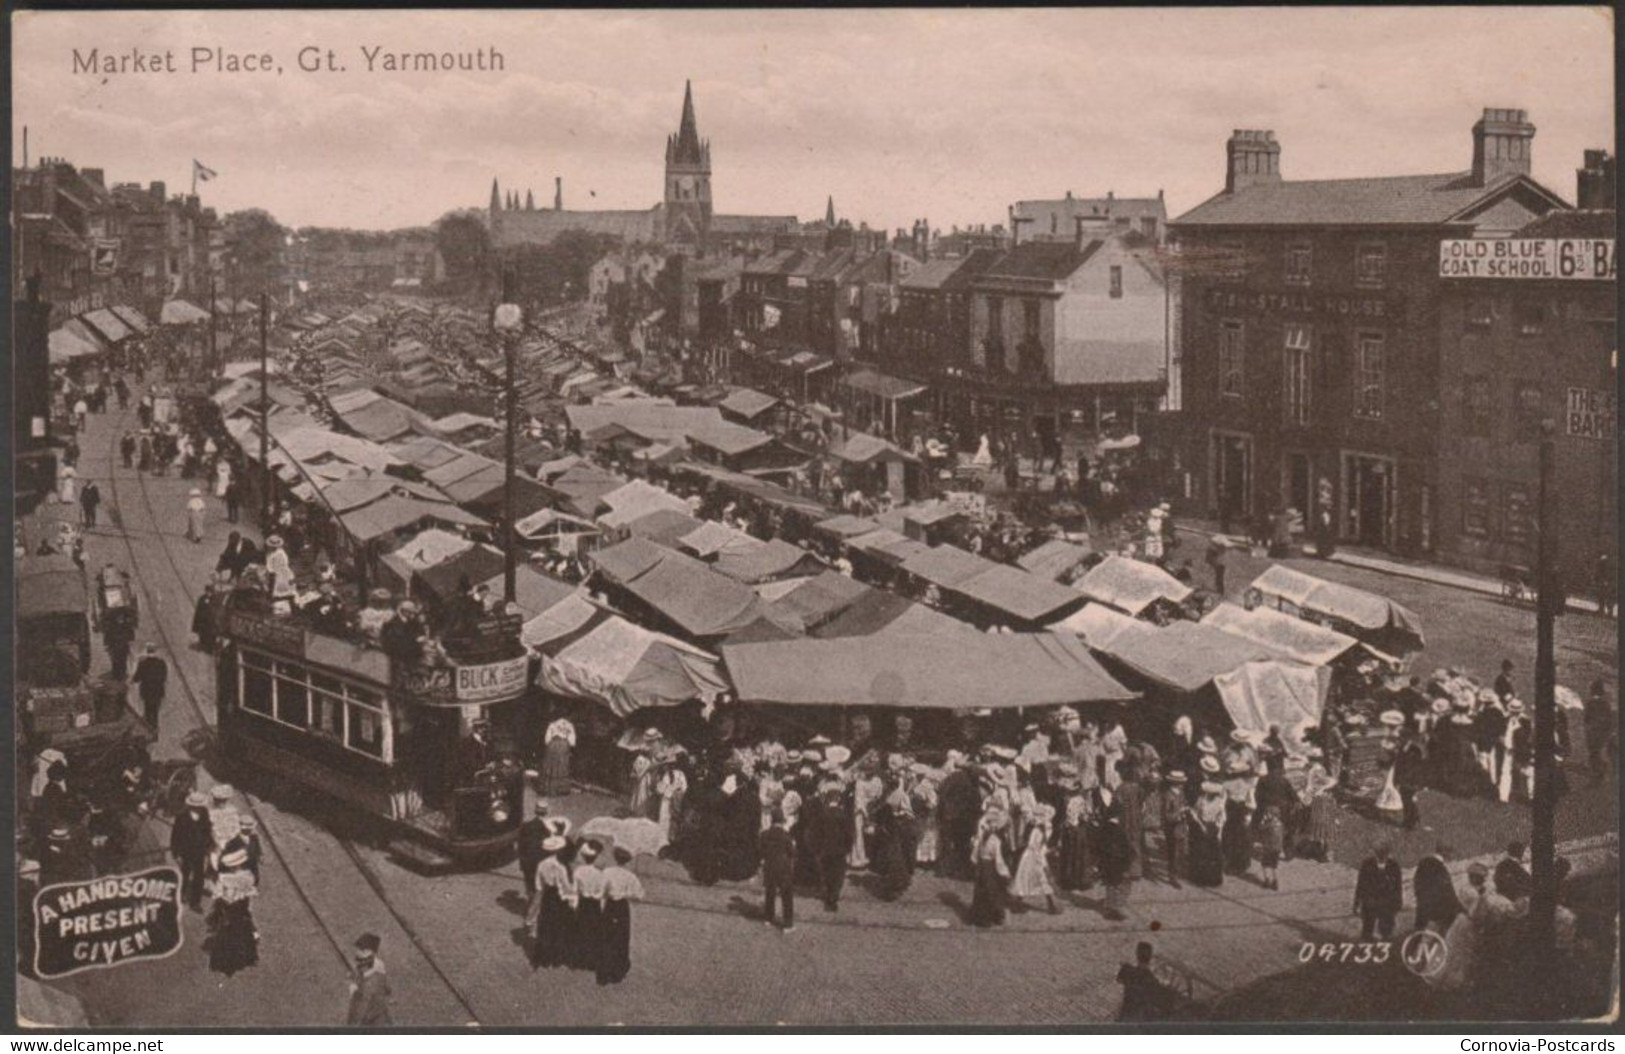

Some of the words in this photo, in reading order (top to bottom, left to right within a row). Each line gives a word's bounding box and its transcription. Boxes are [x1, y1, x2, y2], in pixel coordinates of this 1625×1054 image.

[1451, 241, 1488, 258] OLD
[1494, 241, 1545, 258] BLUE
[1441, 259, 1479, 275] COAT
[1488, 260, 1552, 276] SCHOOL
[1571, 389, 1598, 412] THE
[460, 666, 500, 689] BUCK
[40, 904, 59, 924] A
[58, 878, 176, 913] HANDSOME
[60, 902, 161, 938] PRESENT
[73, 929, 151, 965] GIVEN
